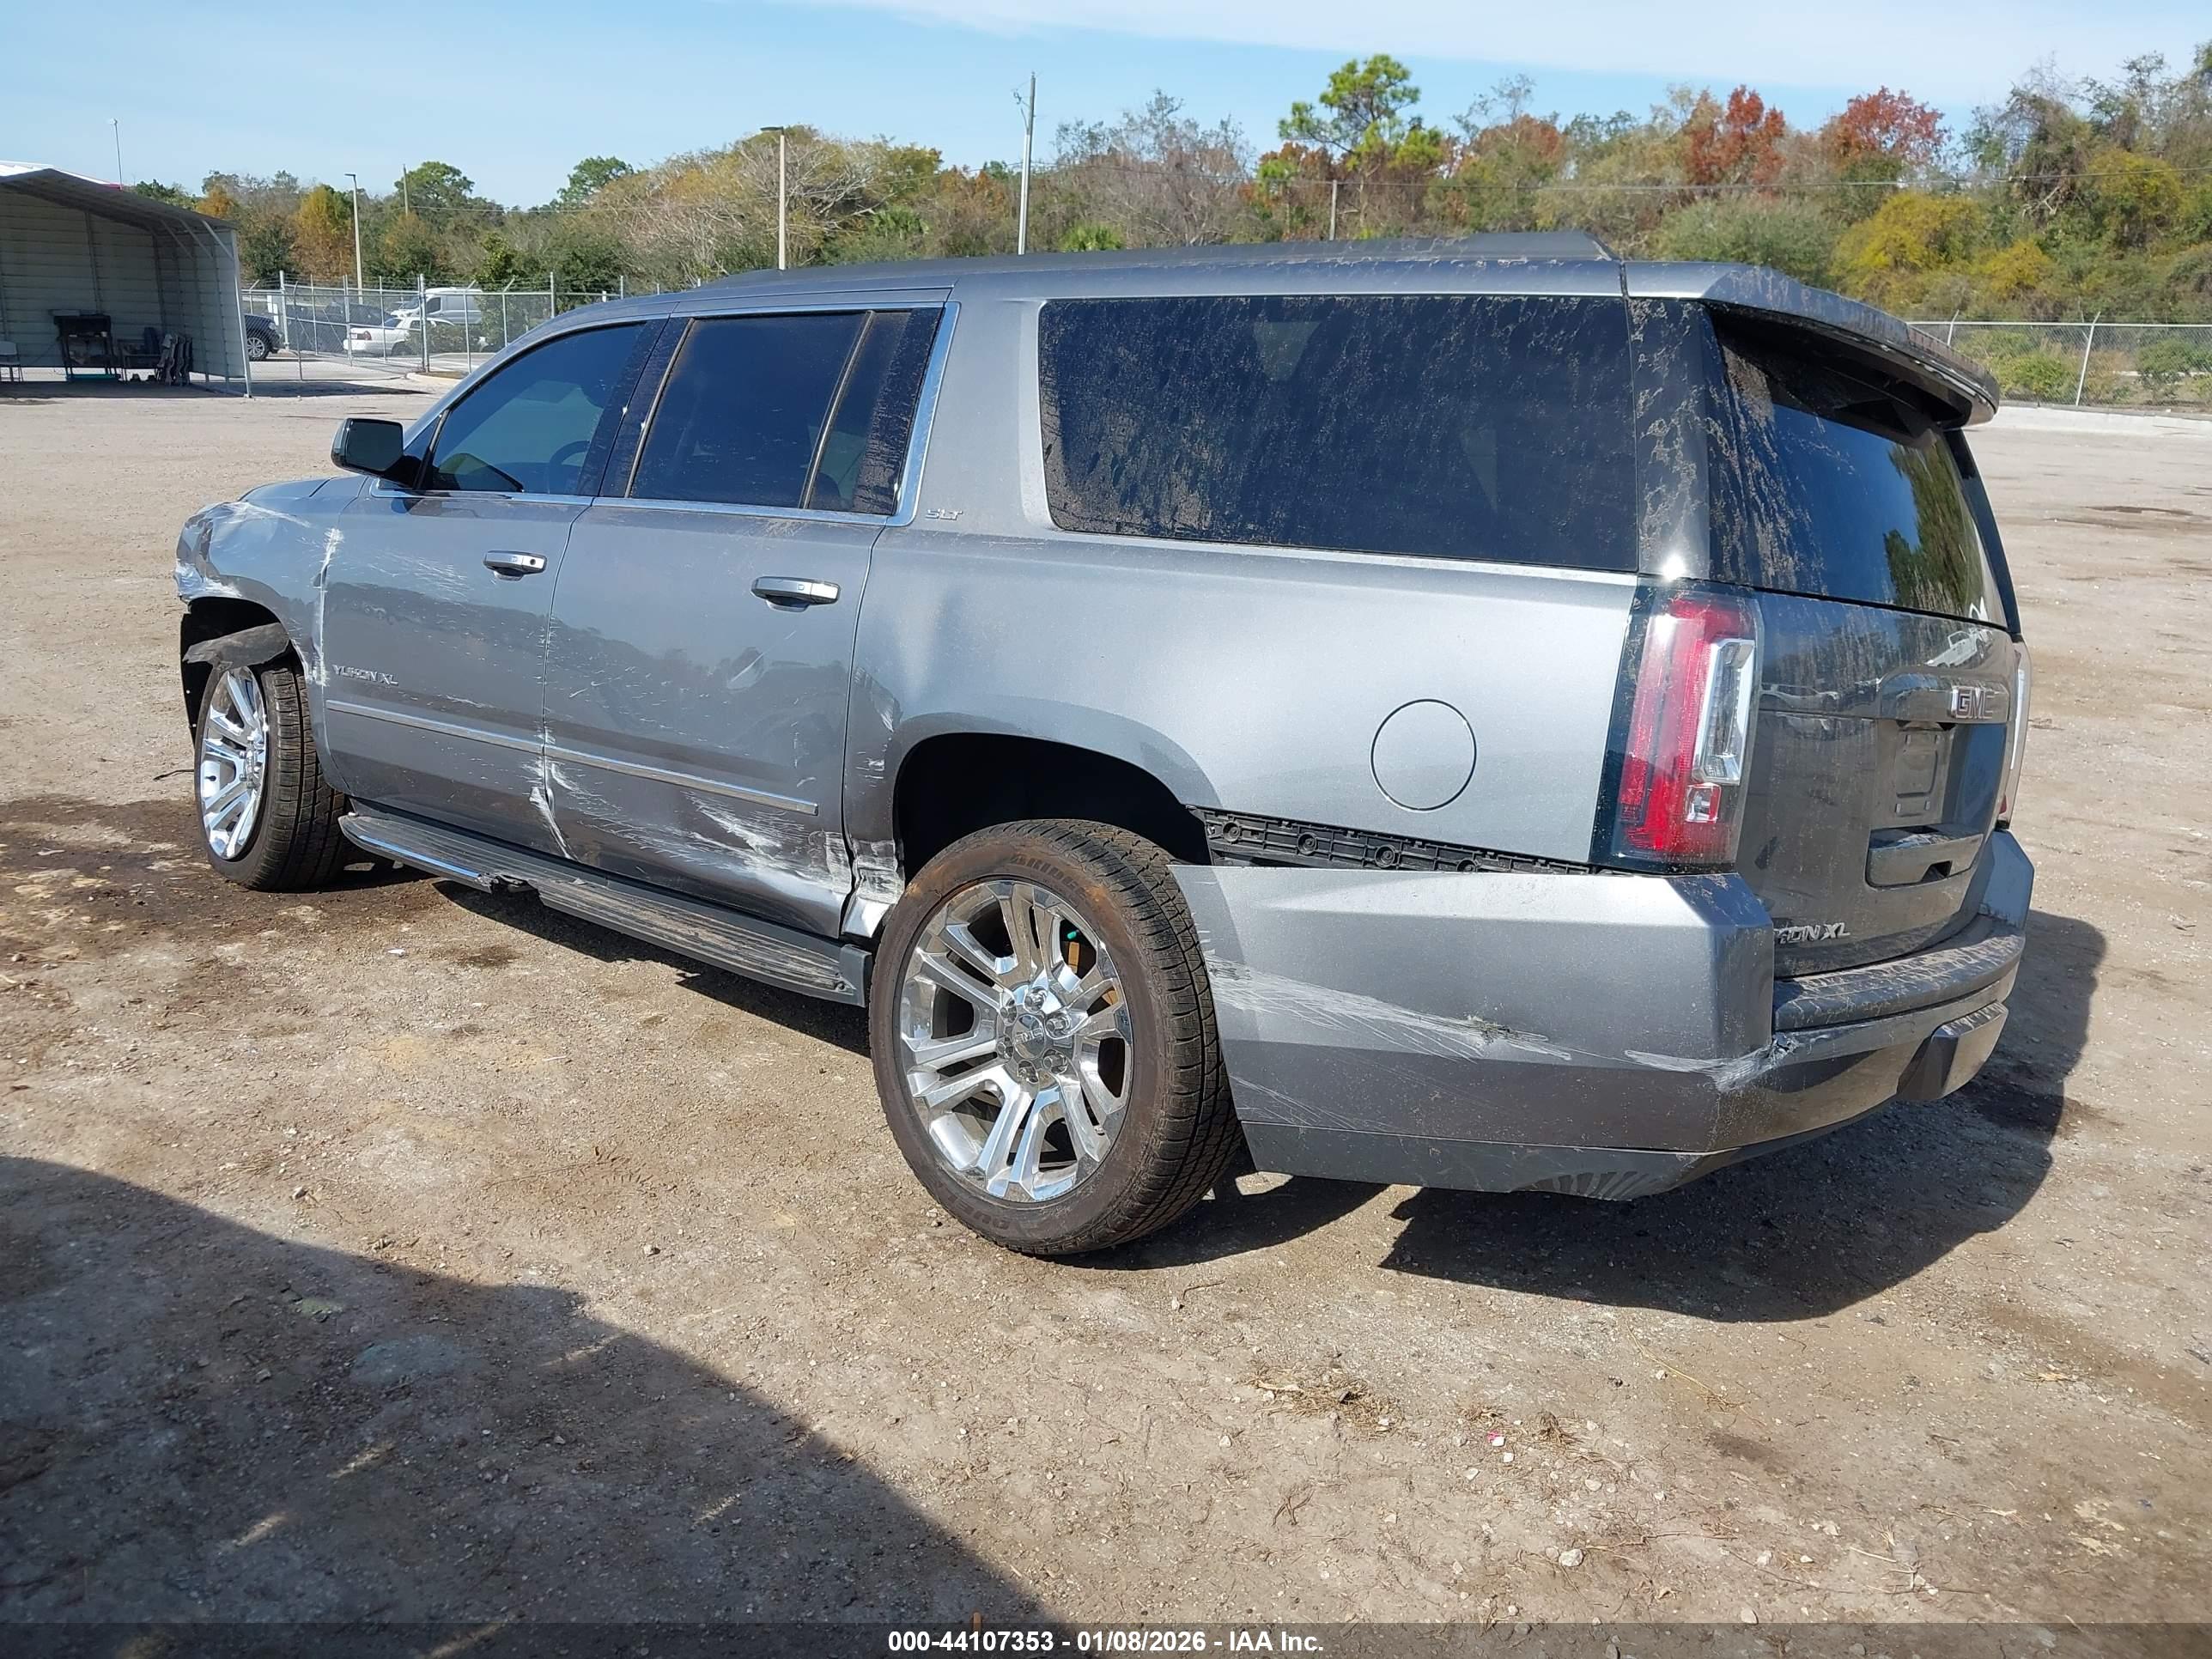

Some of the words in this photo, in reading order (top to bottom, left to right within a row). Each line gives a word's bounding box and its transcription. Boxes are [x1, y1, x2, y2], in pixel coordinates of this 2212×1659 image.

[380, 672, 399, 687] XL
[1951, 684, 1995, 720] GMC
[1820, 921, 1851, 941] XL
